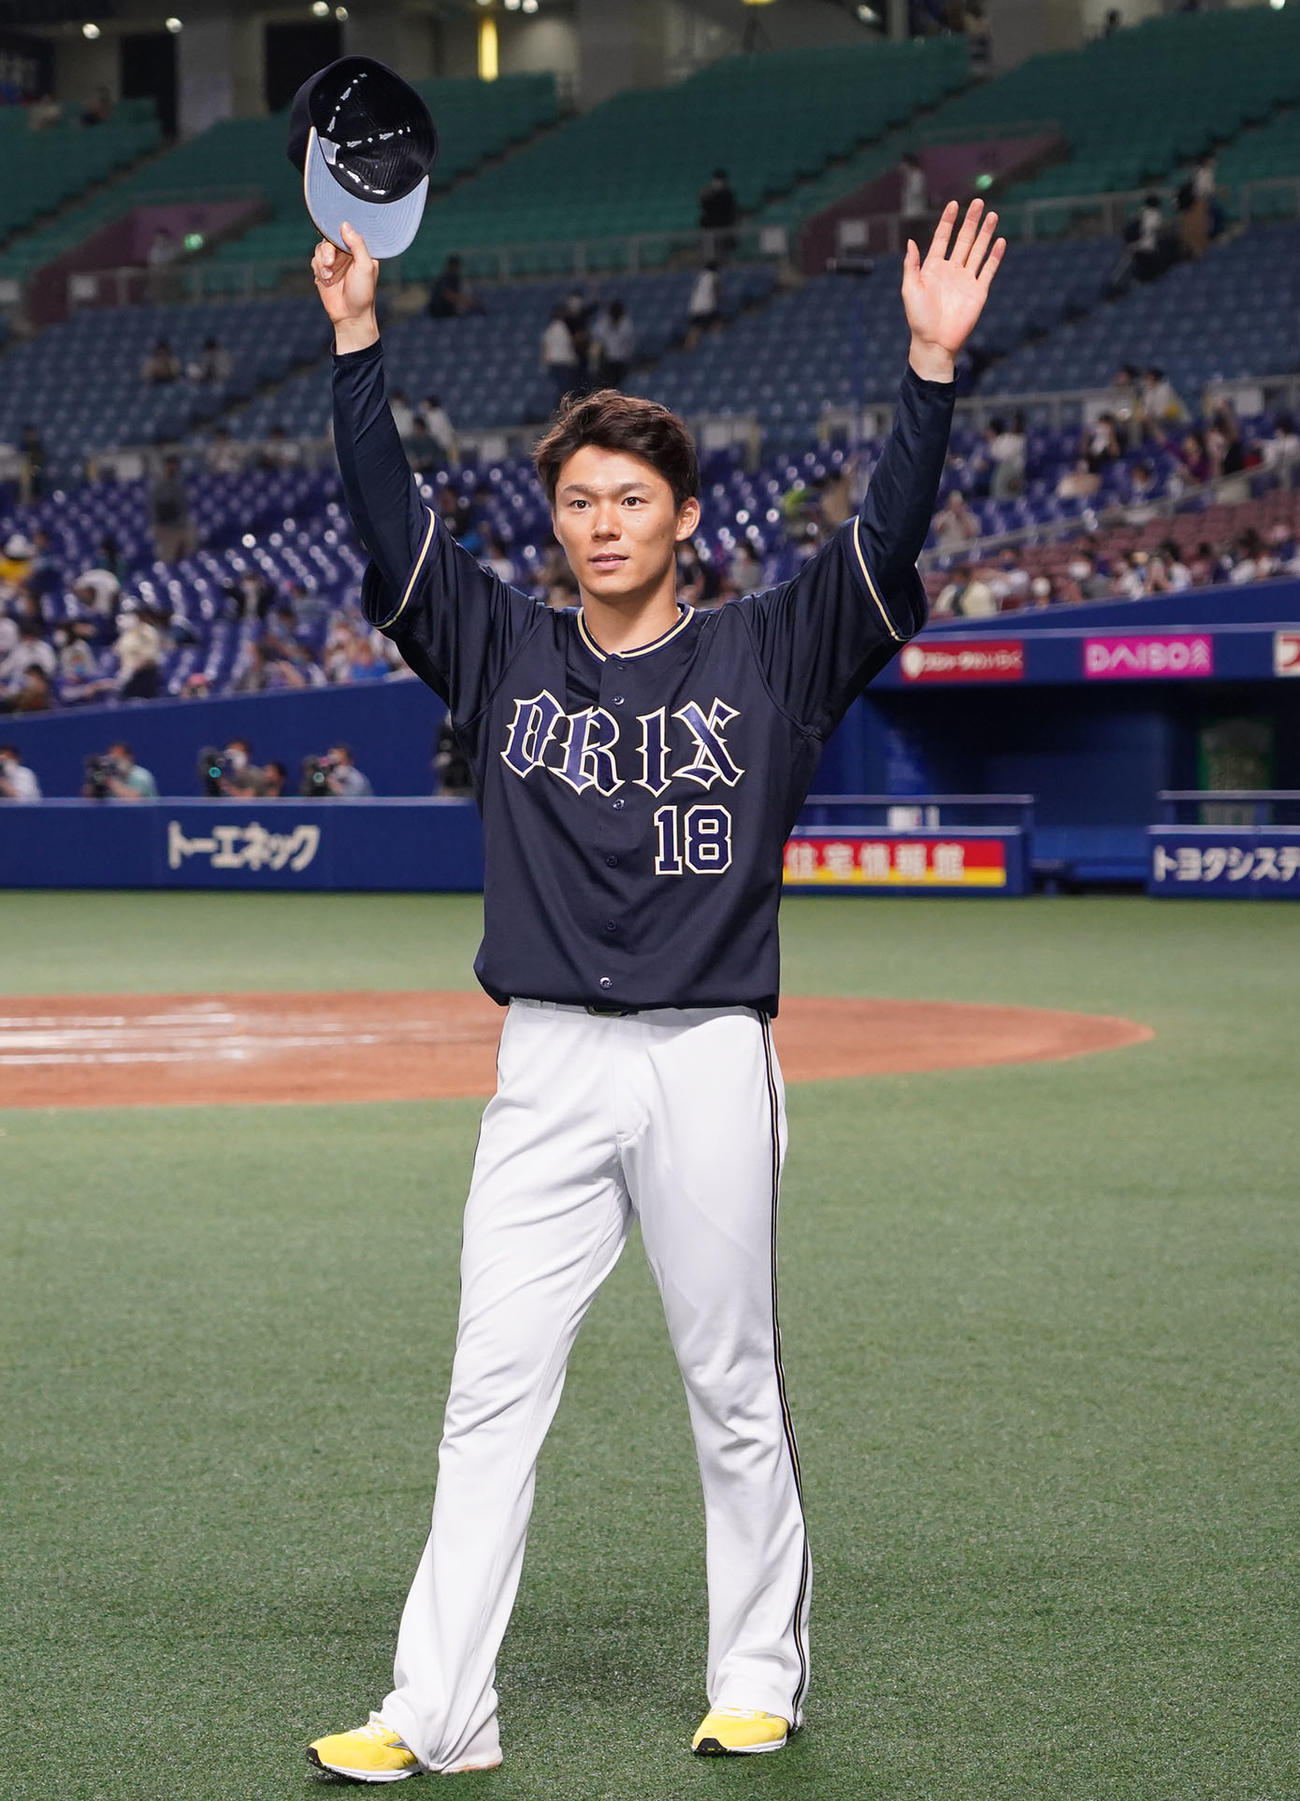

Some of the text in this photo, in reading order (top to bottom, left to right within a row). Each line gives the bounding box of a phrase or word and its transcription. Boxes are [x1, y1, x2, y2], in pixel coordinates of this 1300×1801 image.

[1087, 642, 1190, 672] DAISO
[500, 689, 745, 798] ORIX
[168, 820, 320, 871] トーエネック
[654, 804, 732, 875] 18
[1153, 845, 1300, 881] トヨタシステ
